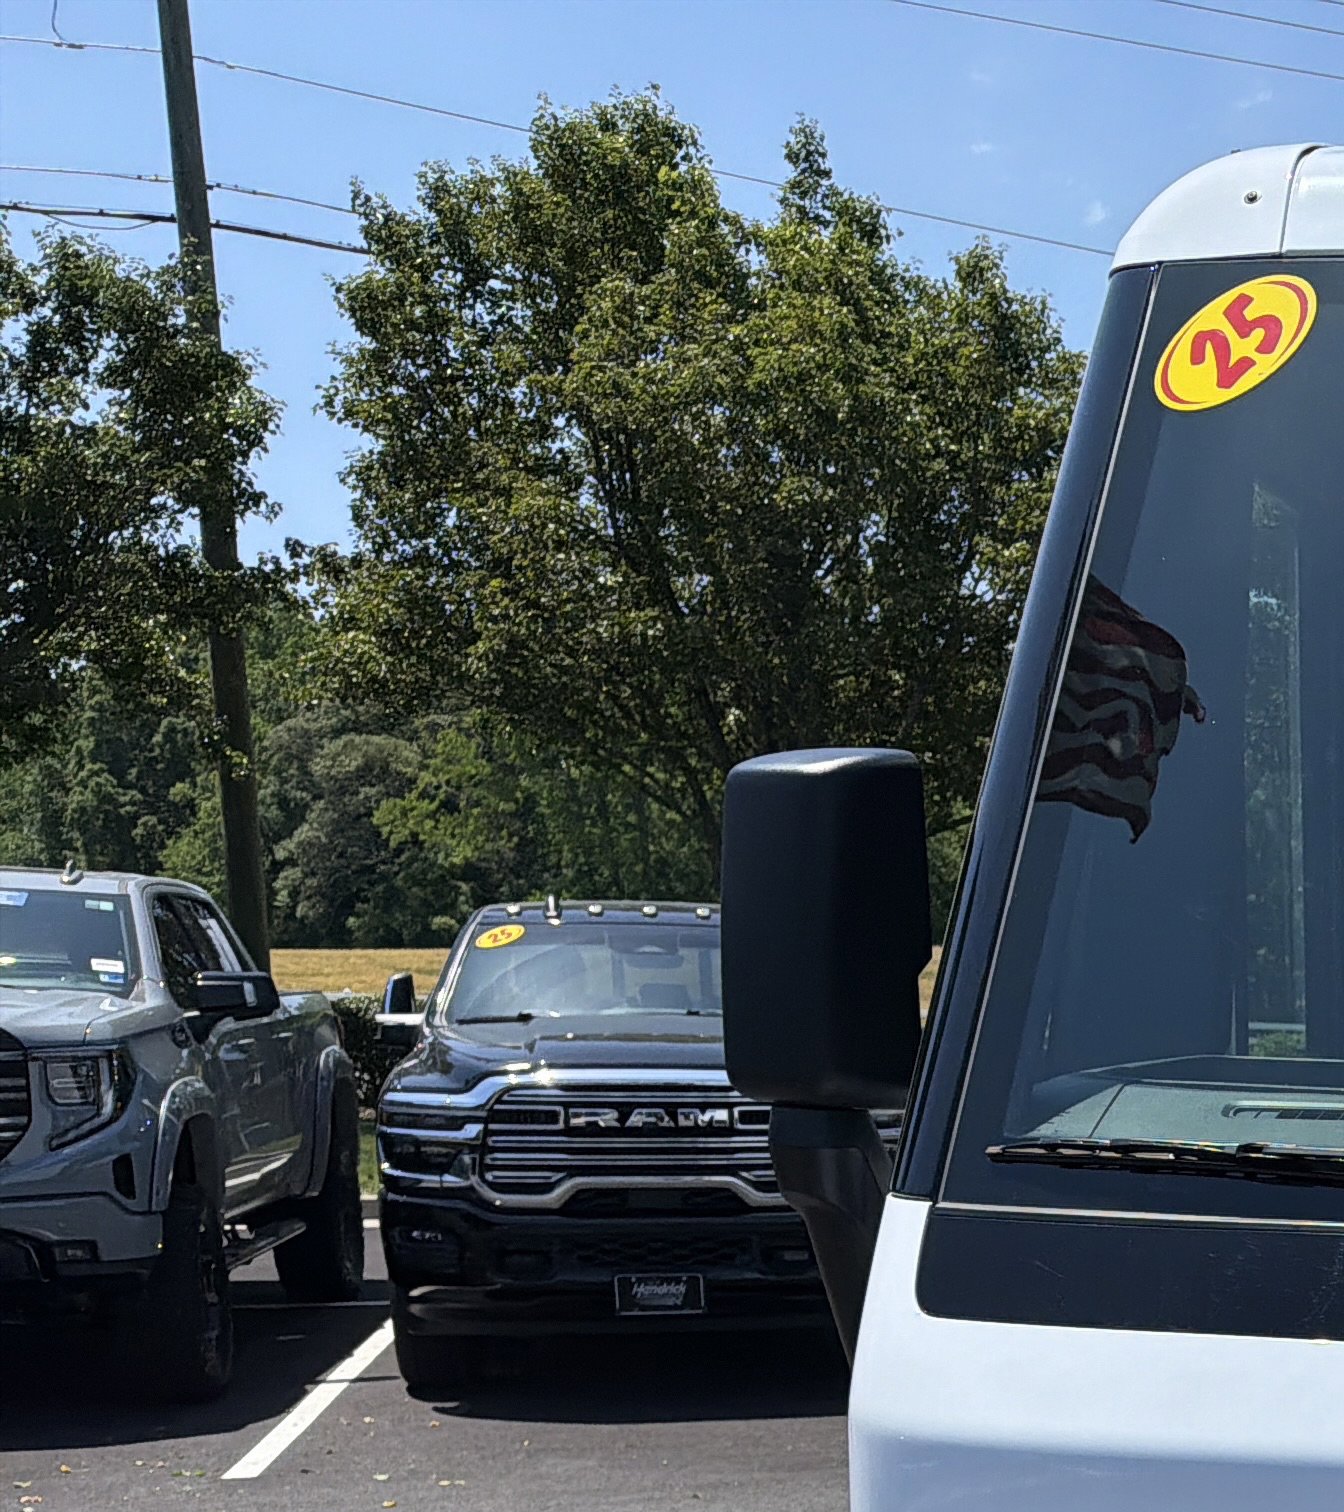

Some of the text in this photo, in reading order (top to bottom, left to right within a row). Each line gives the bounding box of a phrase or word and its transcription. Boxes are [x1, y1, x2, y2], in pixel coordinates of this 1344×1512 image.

[1190, 293, 1283, 389] 25
[487, 928, 513, 943] 25
[569, 1107, 729, 1127] RAM
